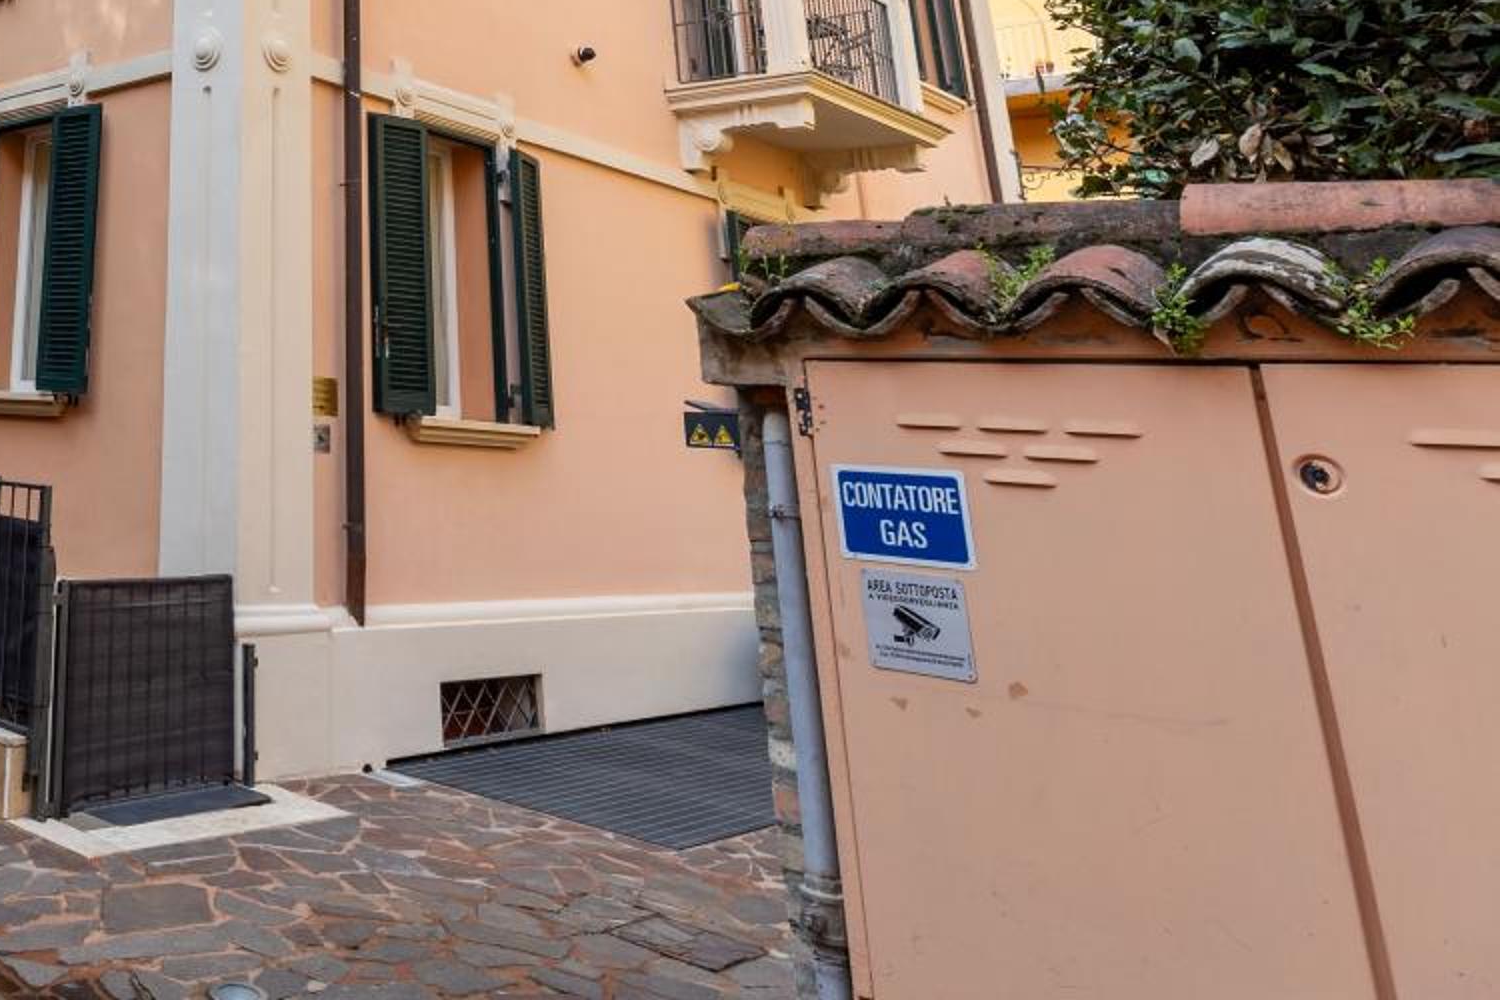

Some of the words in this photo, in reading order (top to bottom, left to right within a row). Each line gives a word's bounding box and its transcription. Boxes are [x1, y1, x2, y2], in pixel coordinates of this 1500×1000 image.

[843, 481, 958, 514] CONTATORE
[880, 519, 927, 549] GAS
[867, 579, 892, 593] AREA
[895, 581, 958, 600] SOTTOPOSTA
